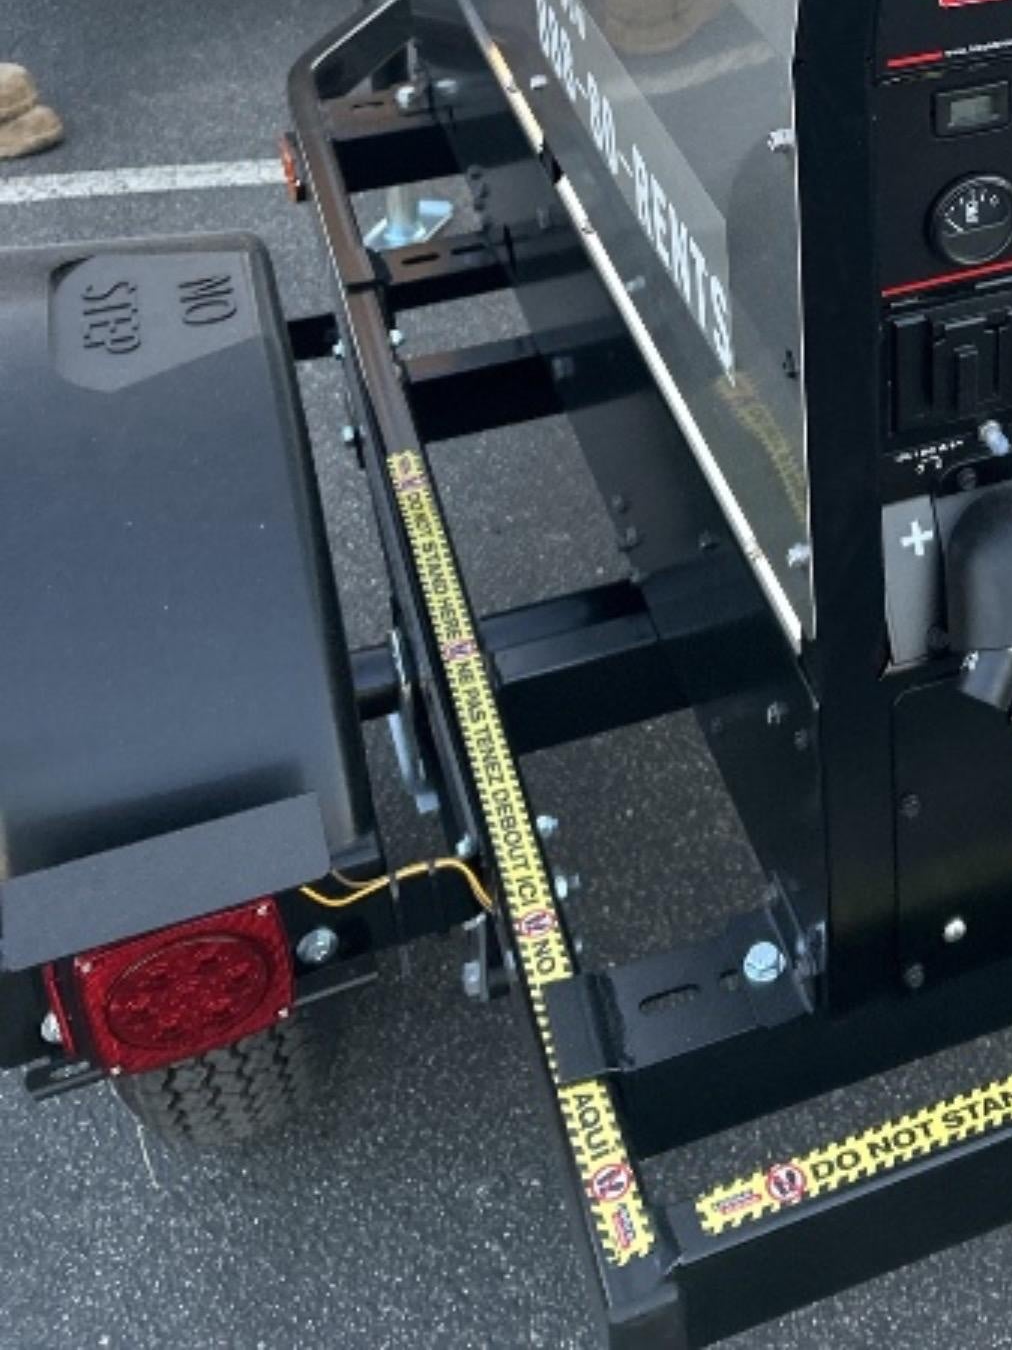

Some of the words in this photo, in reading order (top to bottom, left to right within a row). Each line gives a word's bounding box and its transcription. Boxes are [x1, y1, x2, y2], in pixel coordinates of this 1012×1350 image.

[82, 281, 142, 355] STEP
[177, 274, 238, 327] NO
[422, 542, 448, 595] STAND
[440, 602, 462, 638] HERE
[456, 661, 475, 682] NE
[462, 682, 487, 722] PAS
[473, 719, 504, 786] TENEZ
[490, 787, 530, 870] DEBOUT
[514, 873, 538, 907] ICI
[532, 937, 556, 974] NO
[809, 1150, 862, 1182] DO
[869, 1120, 935, 1161] NOT
